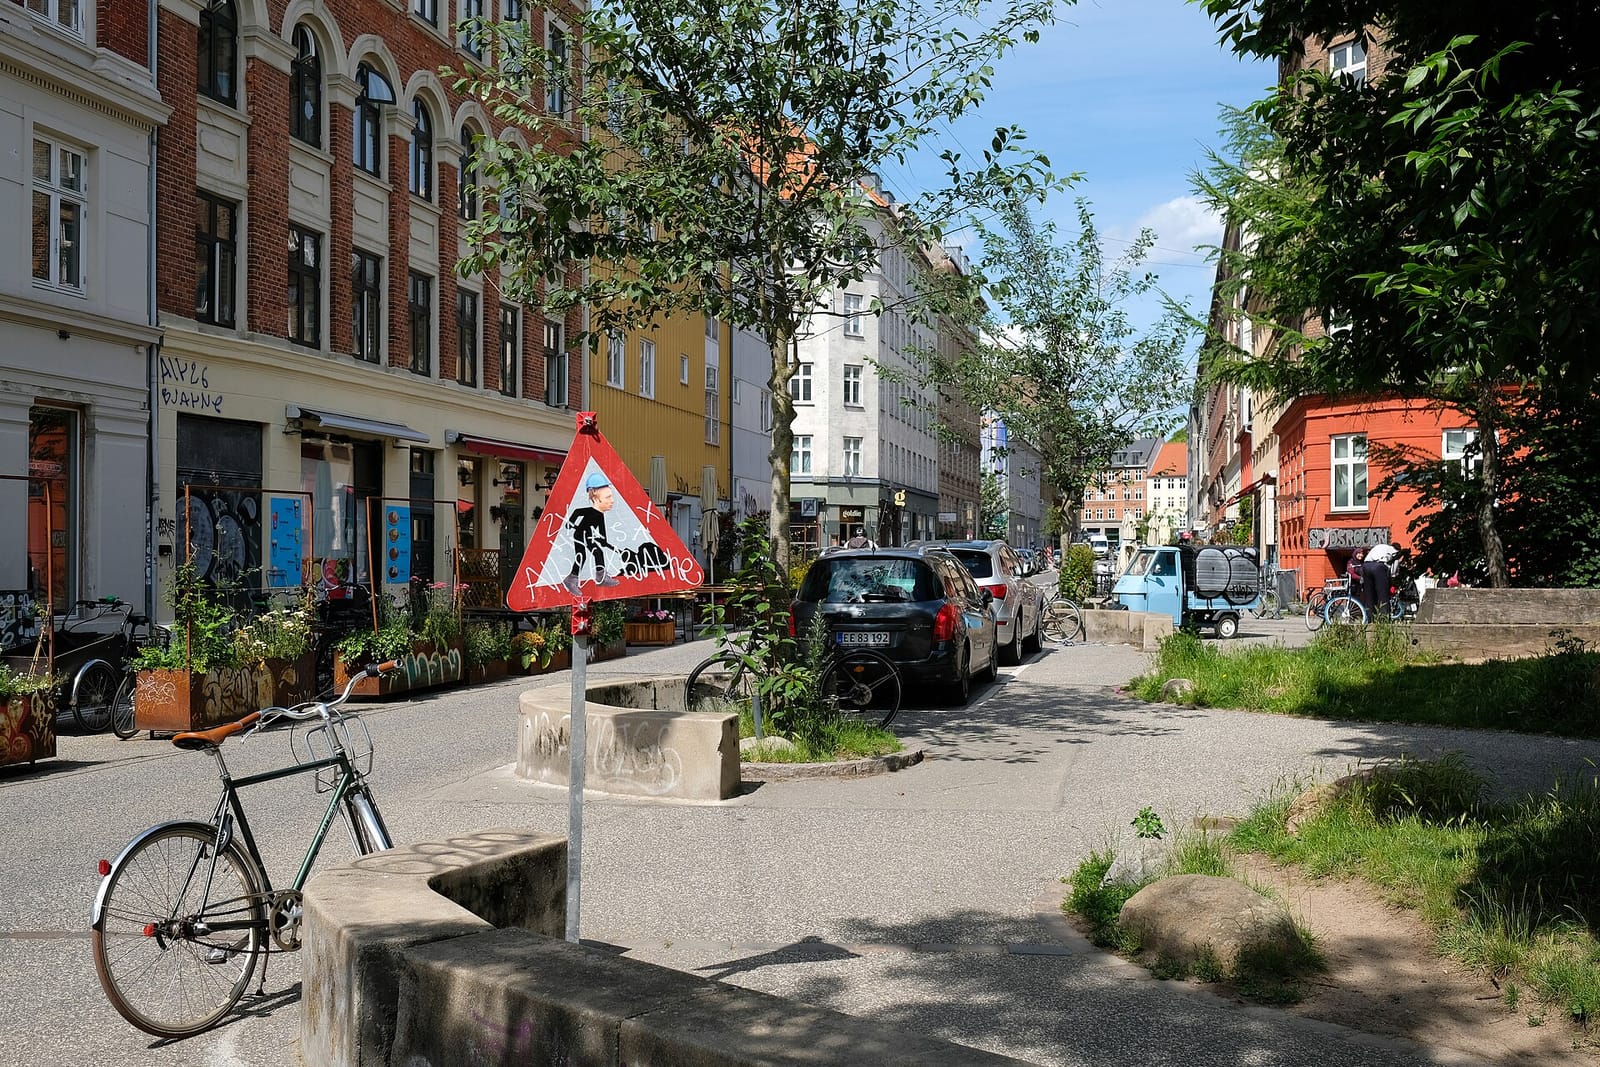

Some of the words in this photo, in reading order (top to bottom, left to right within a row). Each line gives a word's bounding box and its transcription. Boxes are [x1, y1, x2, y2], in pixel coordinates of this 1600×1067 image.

[843, 633, 855, 643] EE
[857, 633, 869, 643] 83
[872, 633, 889, 643] 192
